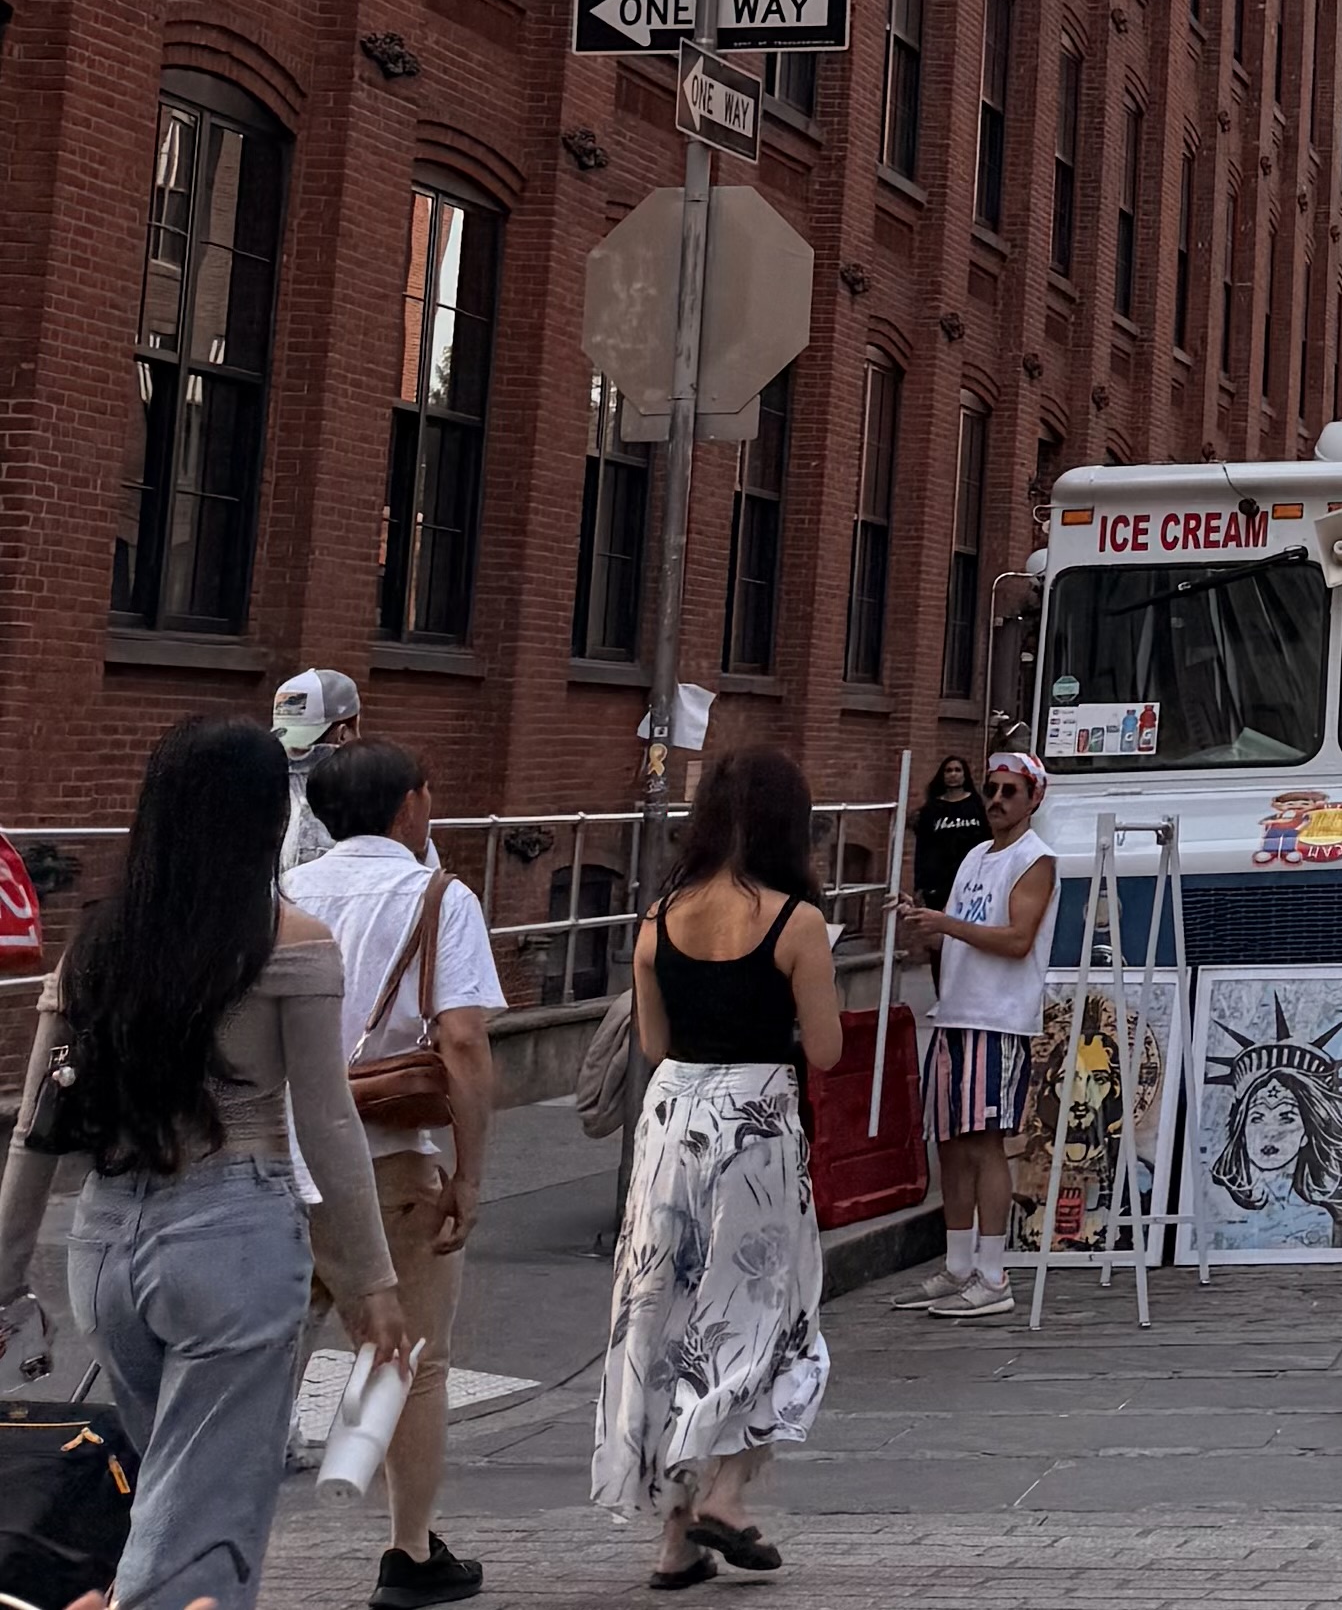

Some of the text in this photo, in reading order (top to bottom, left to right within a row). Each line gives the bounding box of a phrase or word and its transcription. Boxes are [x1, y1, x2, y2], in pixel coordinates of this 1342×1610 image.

[691, 75, 750, 131] ONE WAY
[1098, 510, 1269, 553] ICE CREAM
